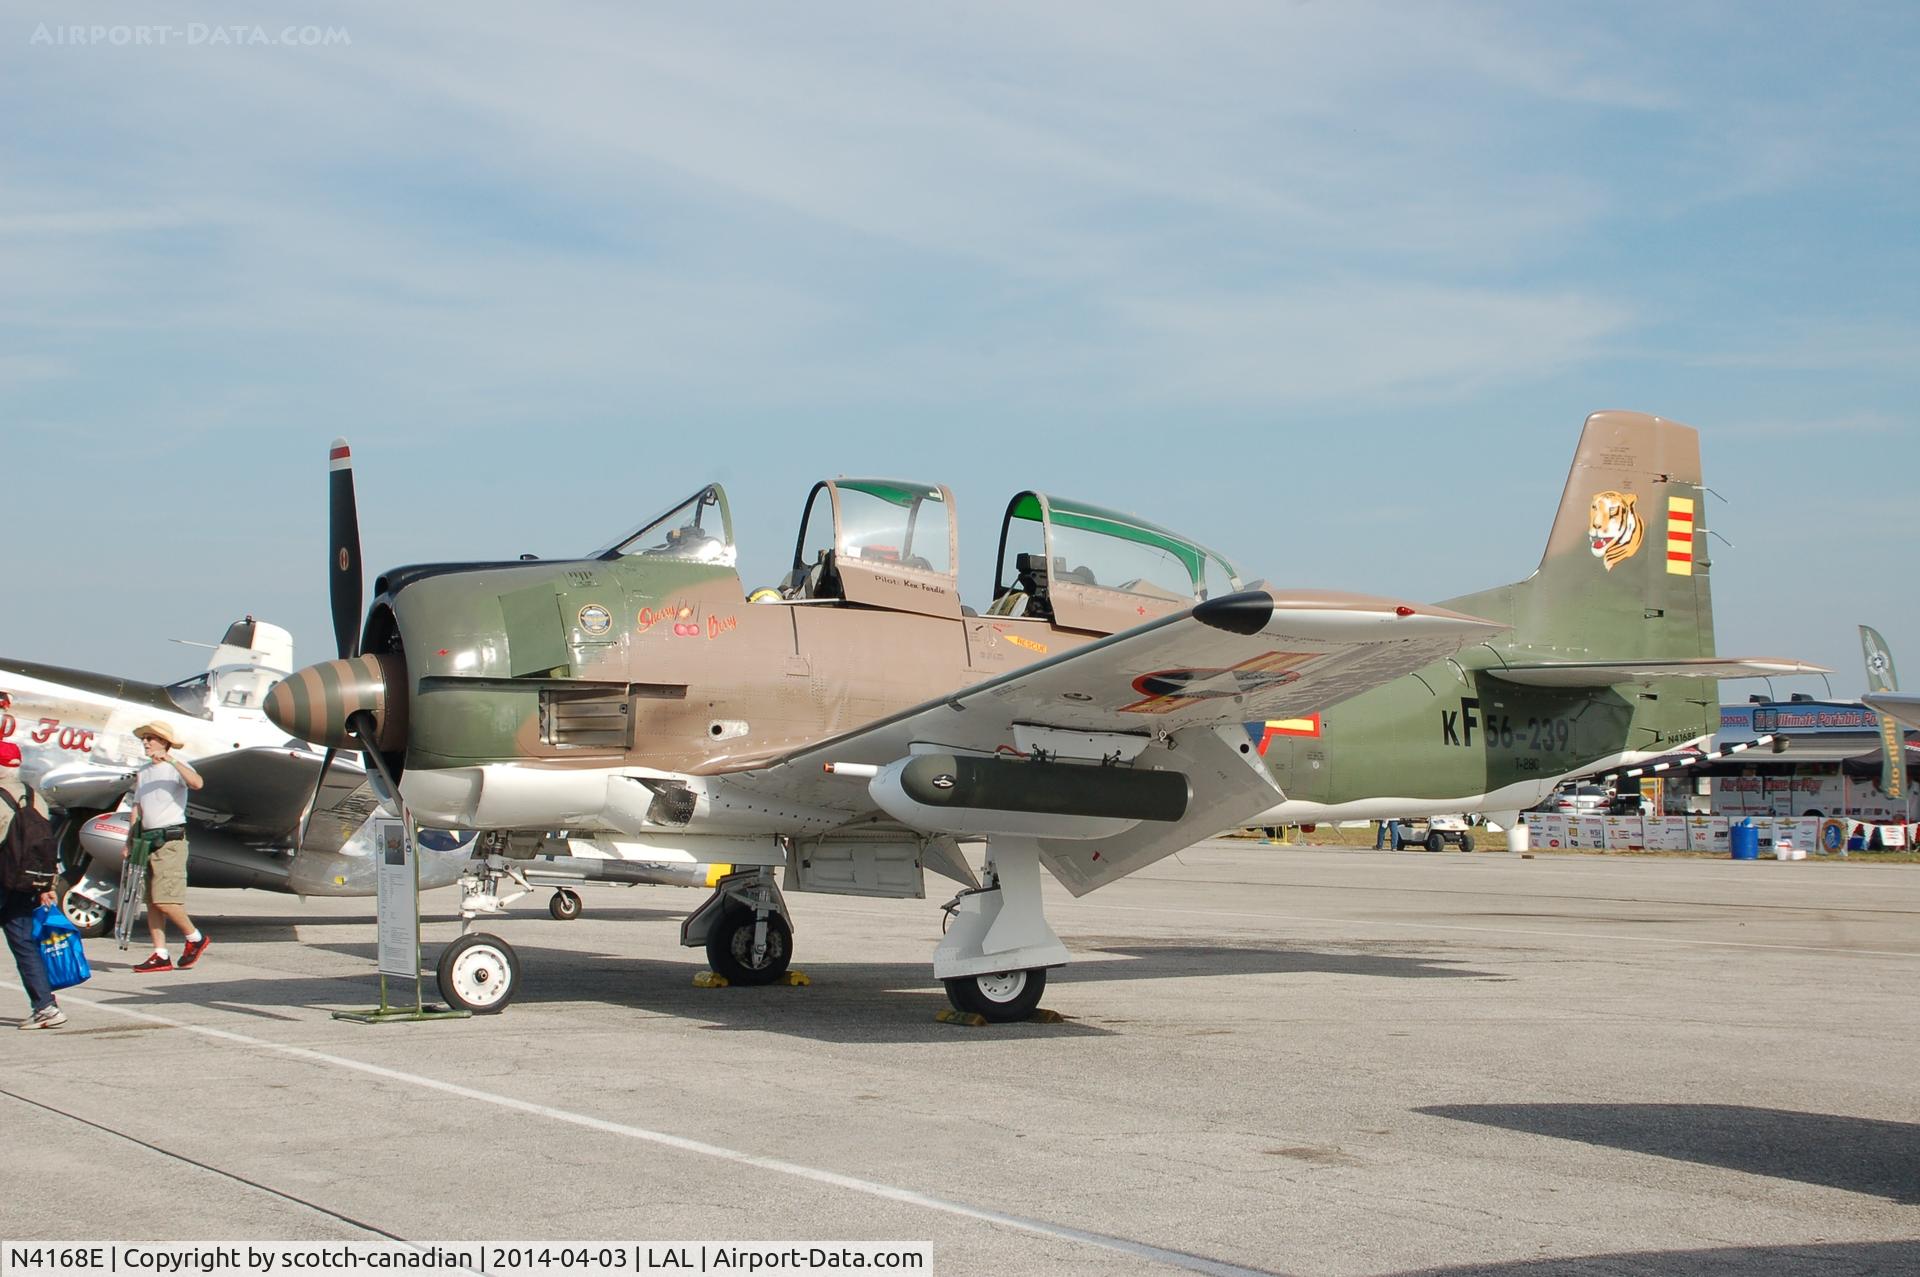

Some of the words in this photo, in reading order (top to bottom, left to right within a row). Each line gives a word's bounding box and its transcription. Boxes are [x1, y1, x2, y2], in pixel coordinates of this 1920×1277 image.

[903, 579, 919, 589] Ken
[1776, 713, 1816, 727] Ultimate
[1817, 711, 1861, 728] Portable
[31, 717, 94, 752] Fox
[1486, 715, 1569, 751] 56-239
[1667, 731, 1697, 744] N4168E
